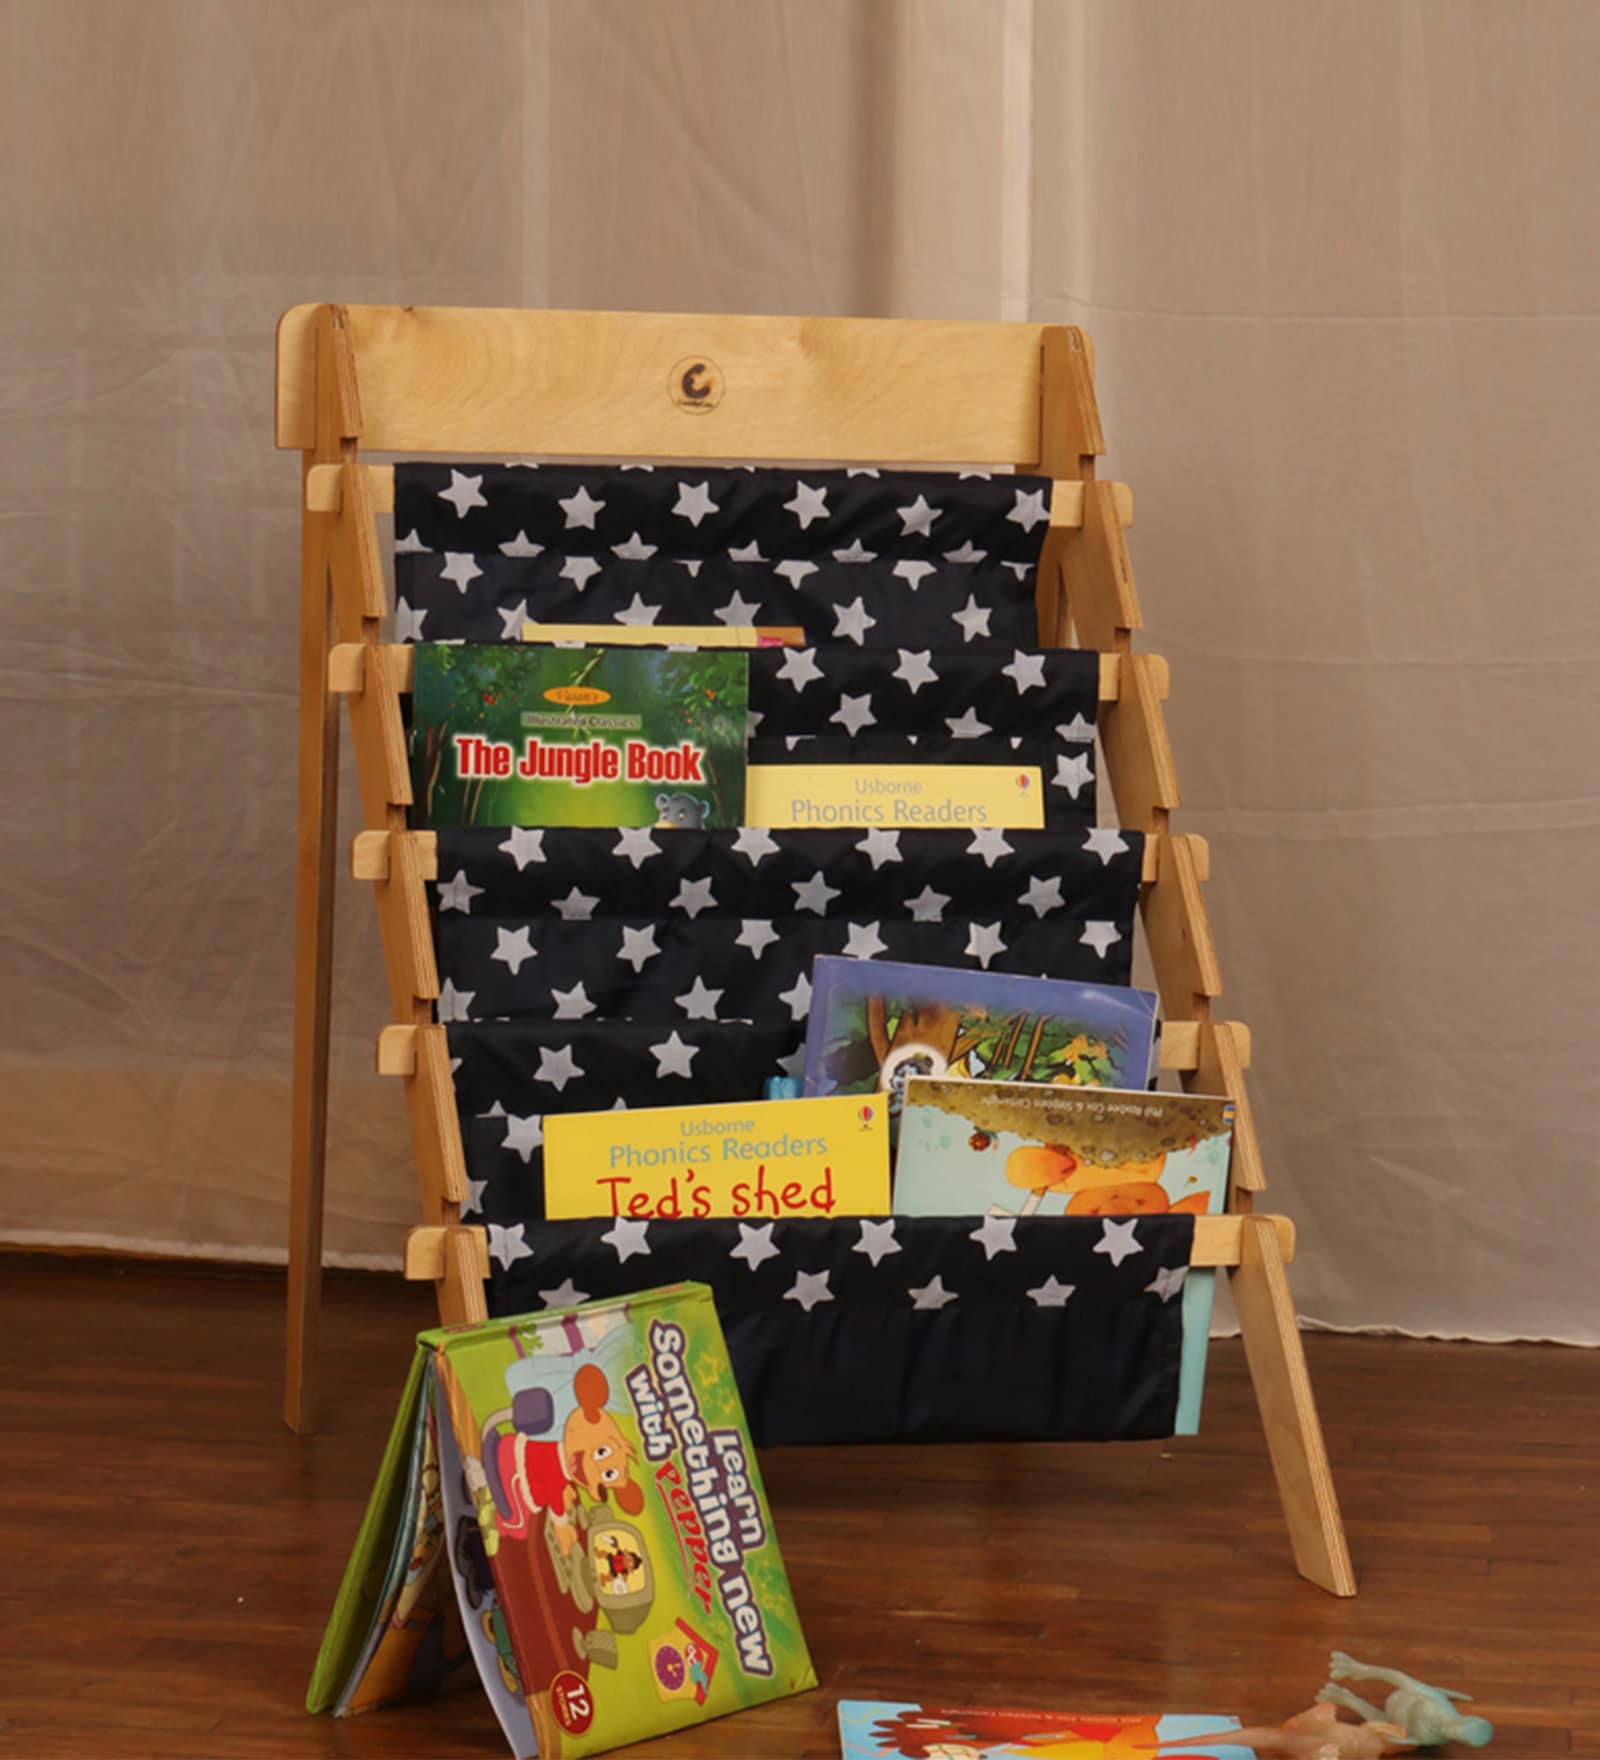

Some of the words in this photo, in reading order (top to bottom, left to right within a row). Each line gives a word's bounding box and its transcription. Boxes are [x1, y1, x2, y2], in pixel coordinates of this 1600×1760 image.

[455, 737, 511, 777] The
[519, 739, 619, 784] Jungle
[627, 741, 704, 782] Book
[854, 778, 923, 794] Usborne
[791, 800, 884, 823] Phonics
[893, 800, 987, 823] Readers
[680, 1118, 755, 1137] Usborne
[609, 1141, 712, 1168] Phonics
[722, 1133, 828, 1161] Readers
[596, 1168, 712, 1218] Ted's
[731, 1165, 836, 1216] shed
[628, 1368, 675, 1459] with
[656, 1460, 713, 1614] Pepper
[653, 1324, 740, 1567] Something
[721, 1573, 770, 1675] new
[712, 1432, 764, 1548] Learn
[566, 1684, 590, 1721] 12
